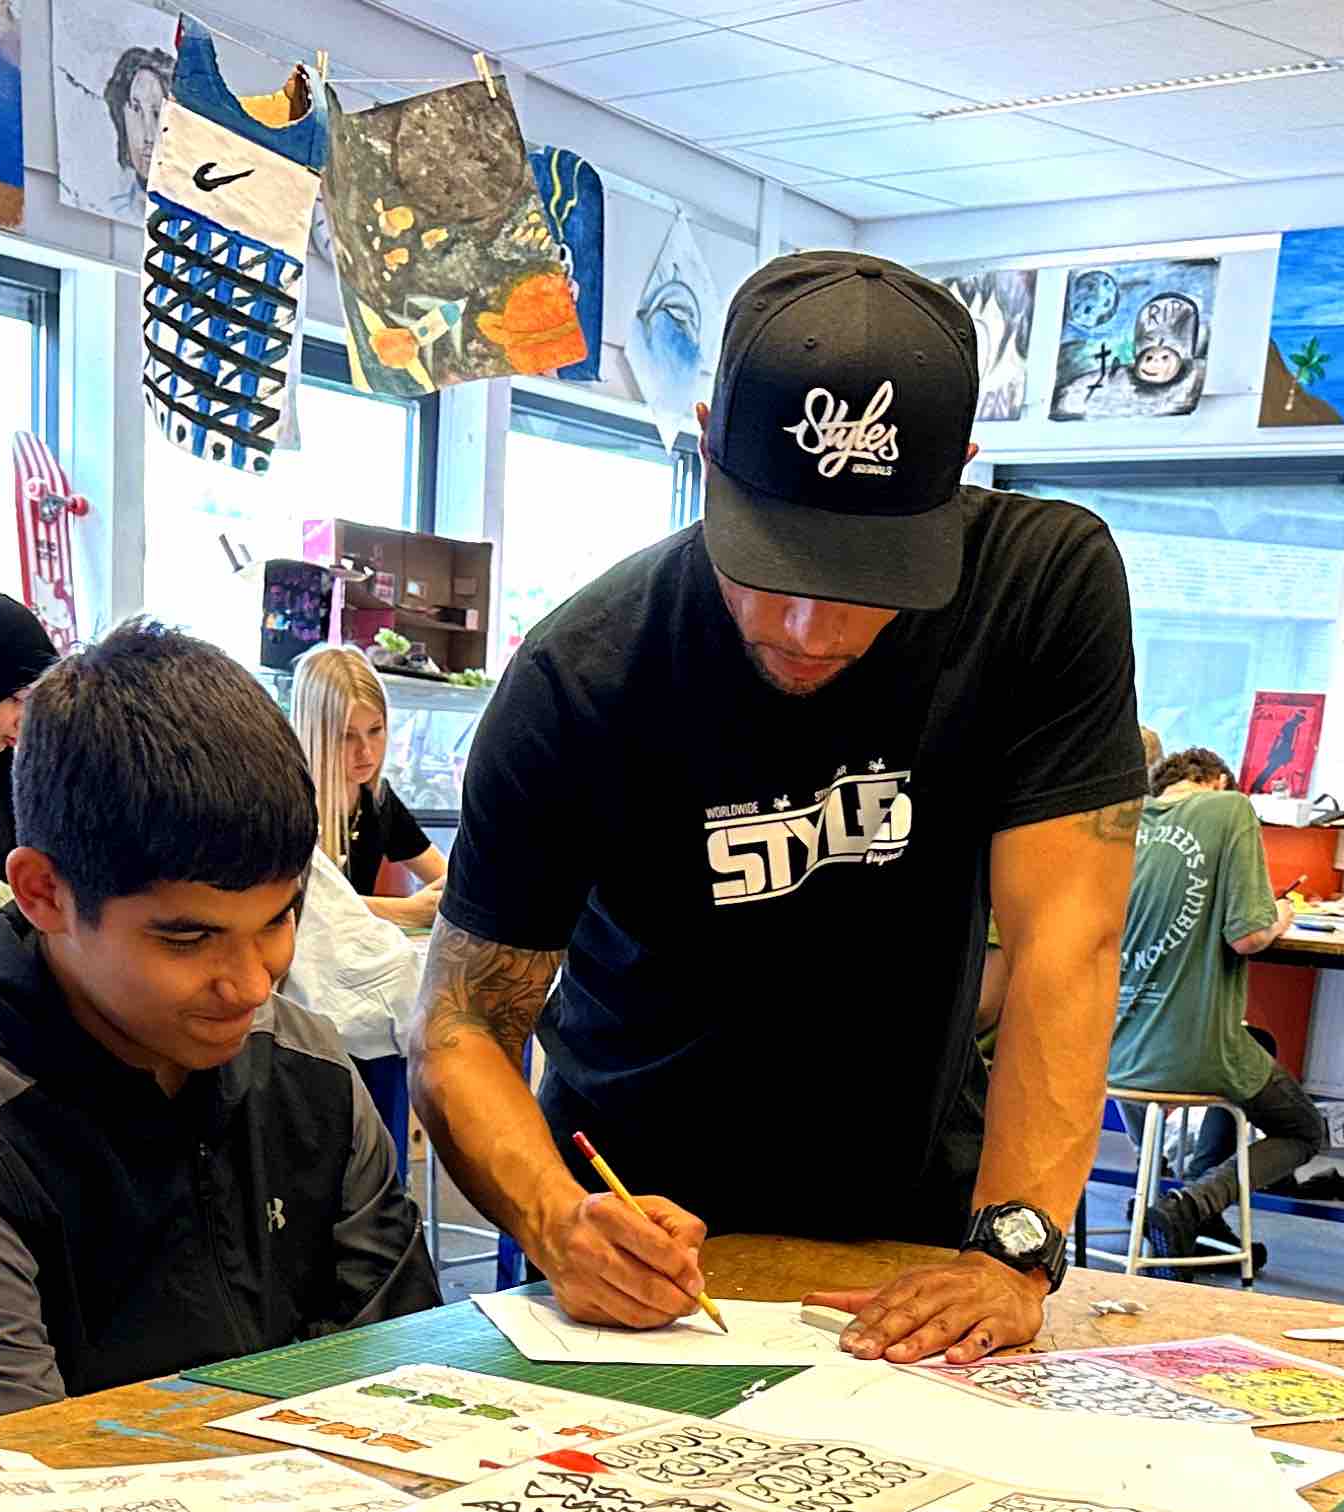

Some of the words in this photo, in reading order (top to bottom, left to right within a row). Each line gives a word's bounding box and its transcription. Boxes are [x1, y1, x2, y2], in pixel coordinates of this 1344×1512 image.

[1147, 300, 1183, 326] RIP
[782, 380, 899, 478] Styles
[705, 801, 760, 819] WORLDWIDE
[1152, 825, 1205, 869] MEETS
